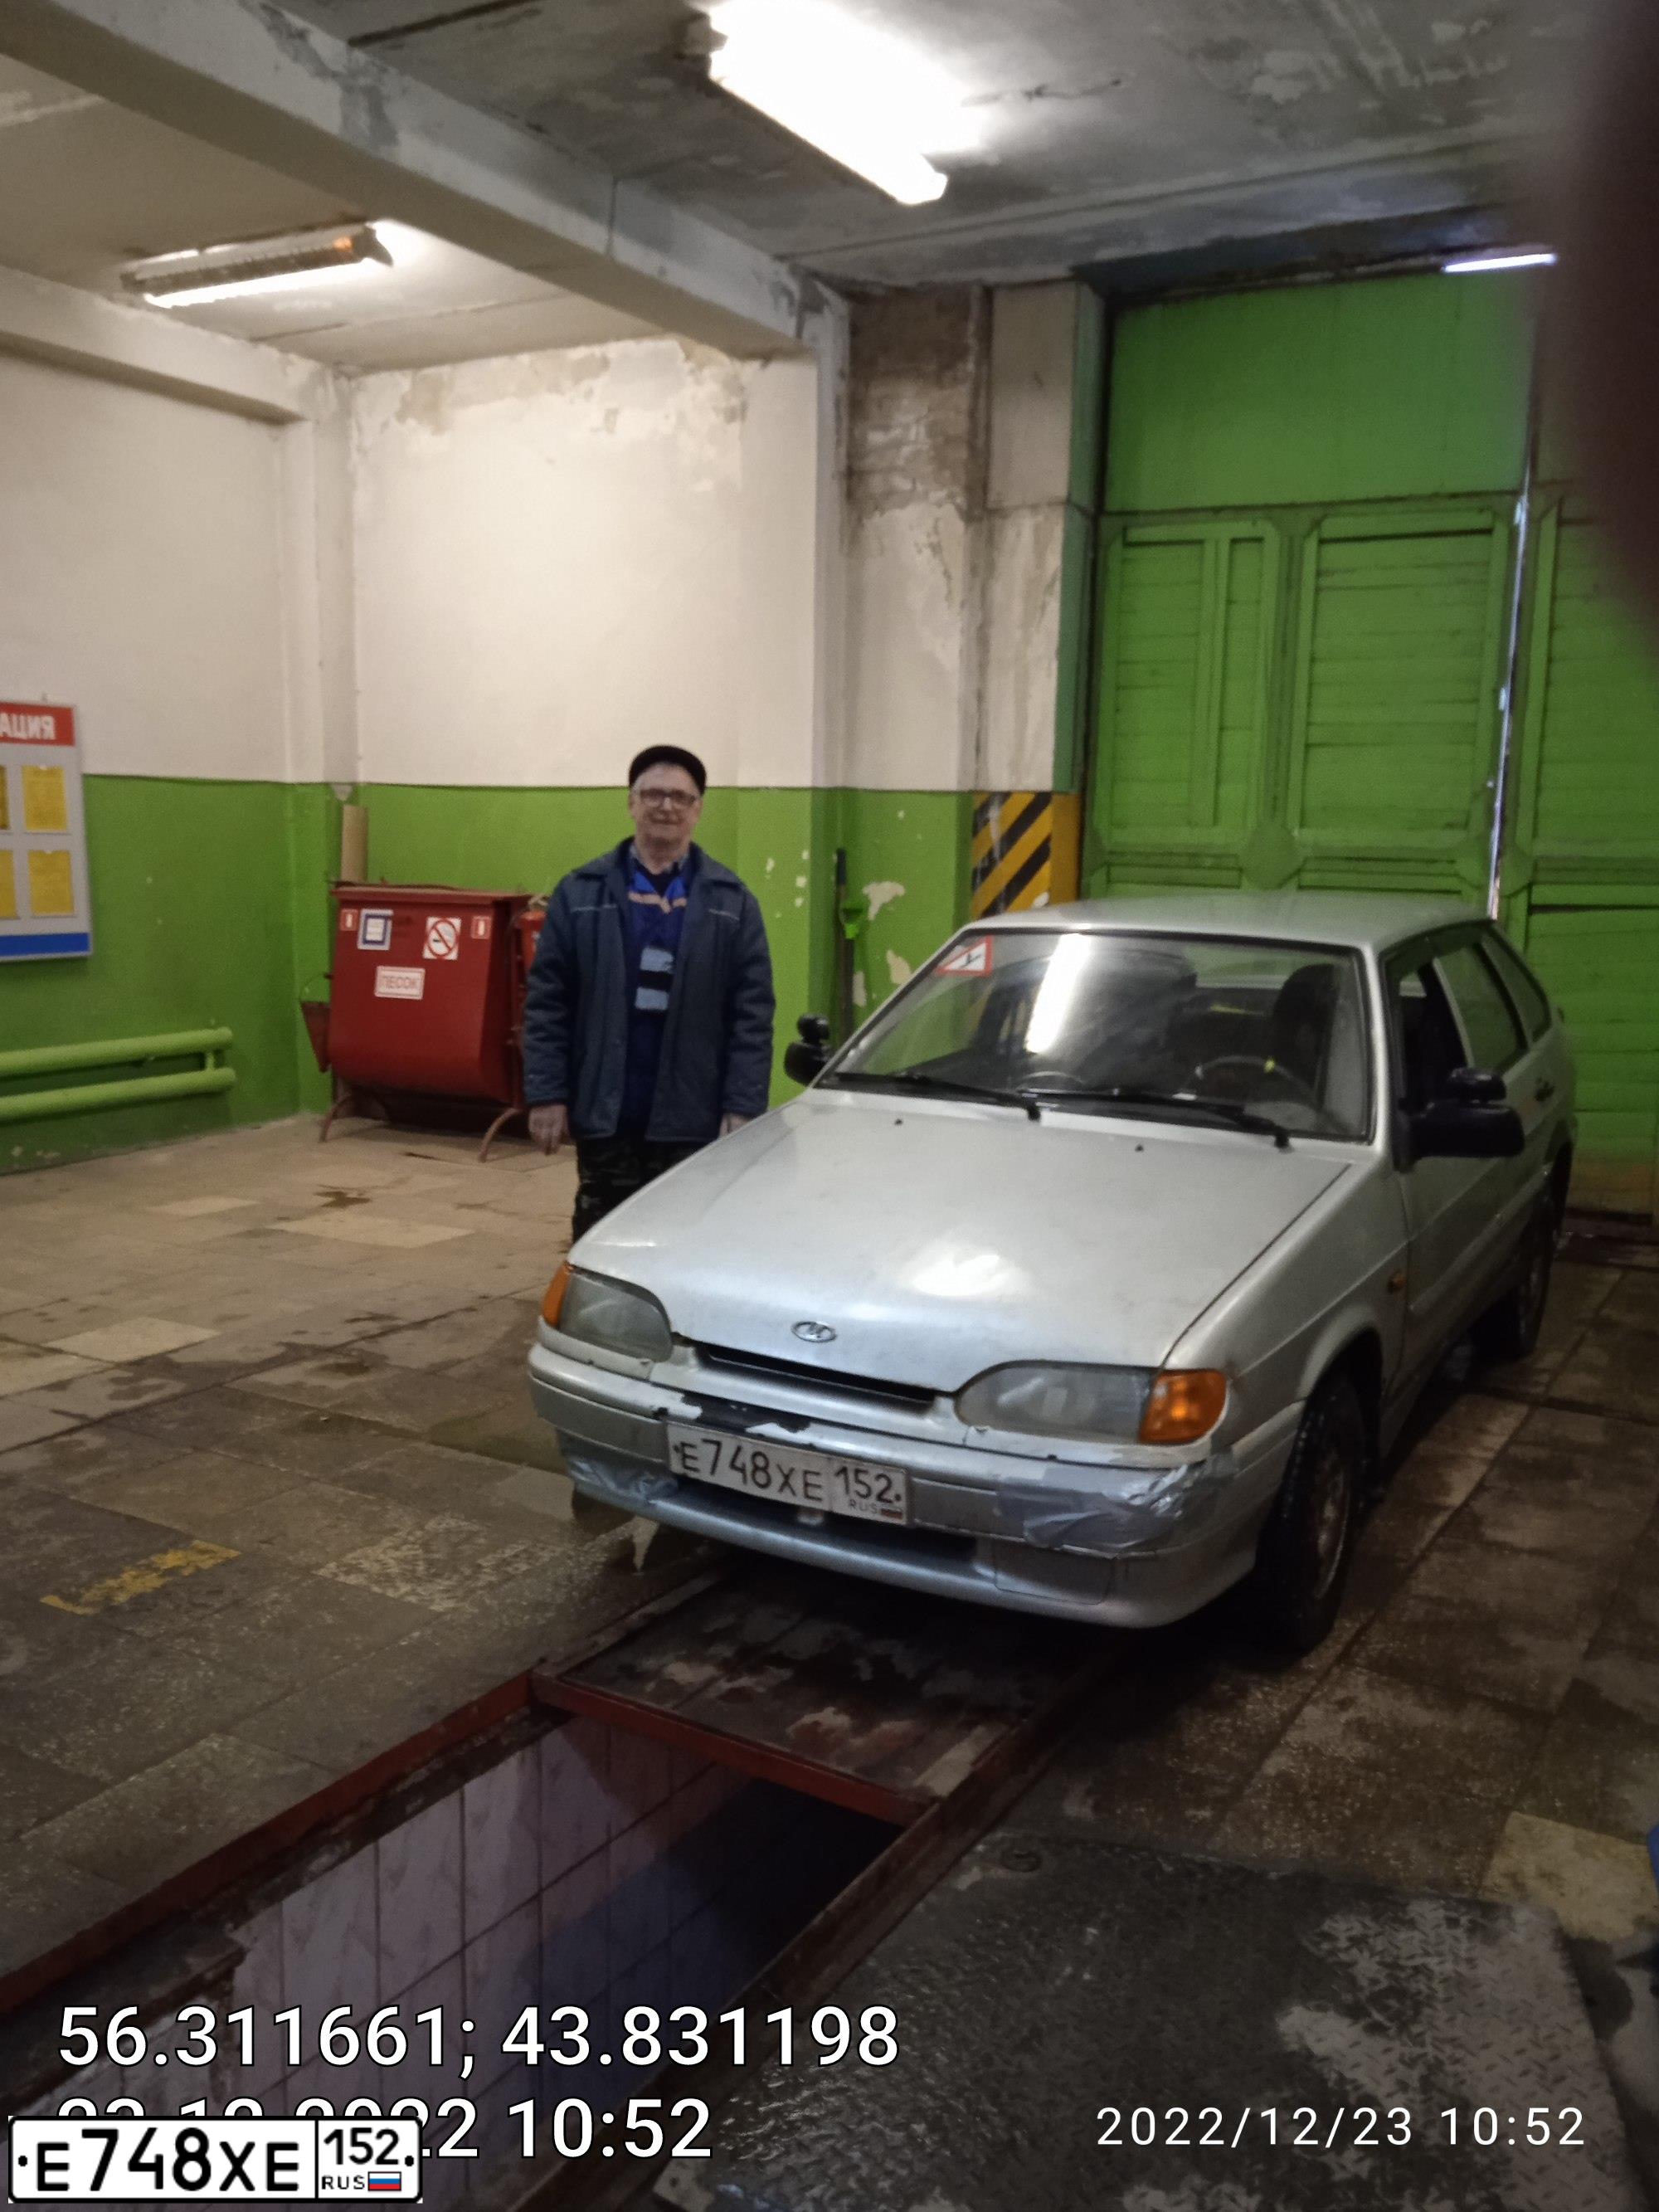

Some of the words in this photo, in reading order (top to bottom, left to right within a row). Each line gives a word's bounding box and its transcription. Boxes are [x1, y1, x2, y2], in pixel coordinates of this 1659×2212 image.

[680, 1438, 824, 1502] Е748ХЕ
[835, 1465, 893, 1504] 152
[849, 1498, 878, 1515] RUS
